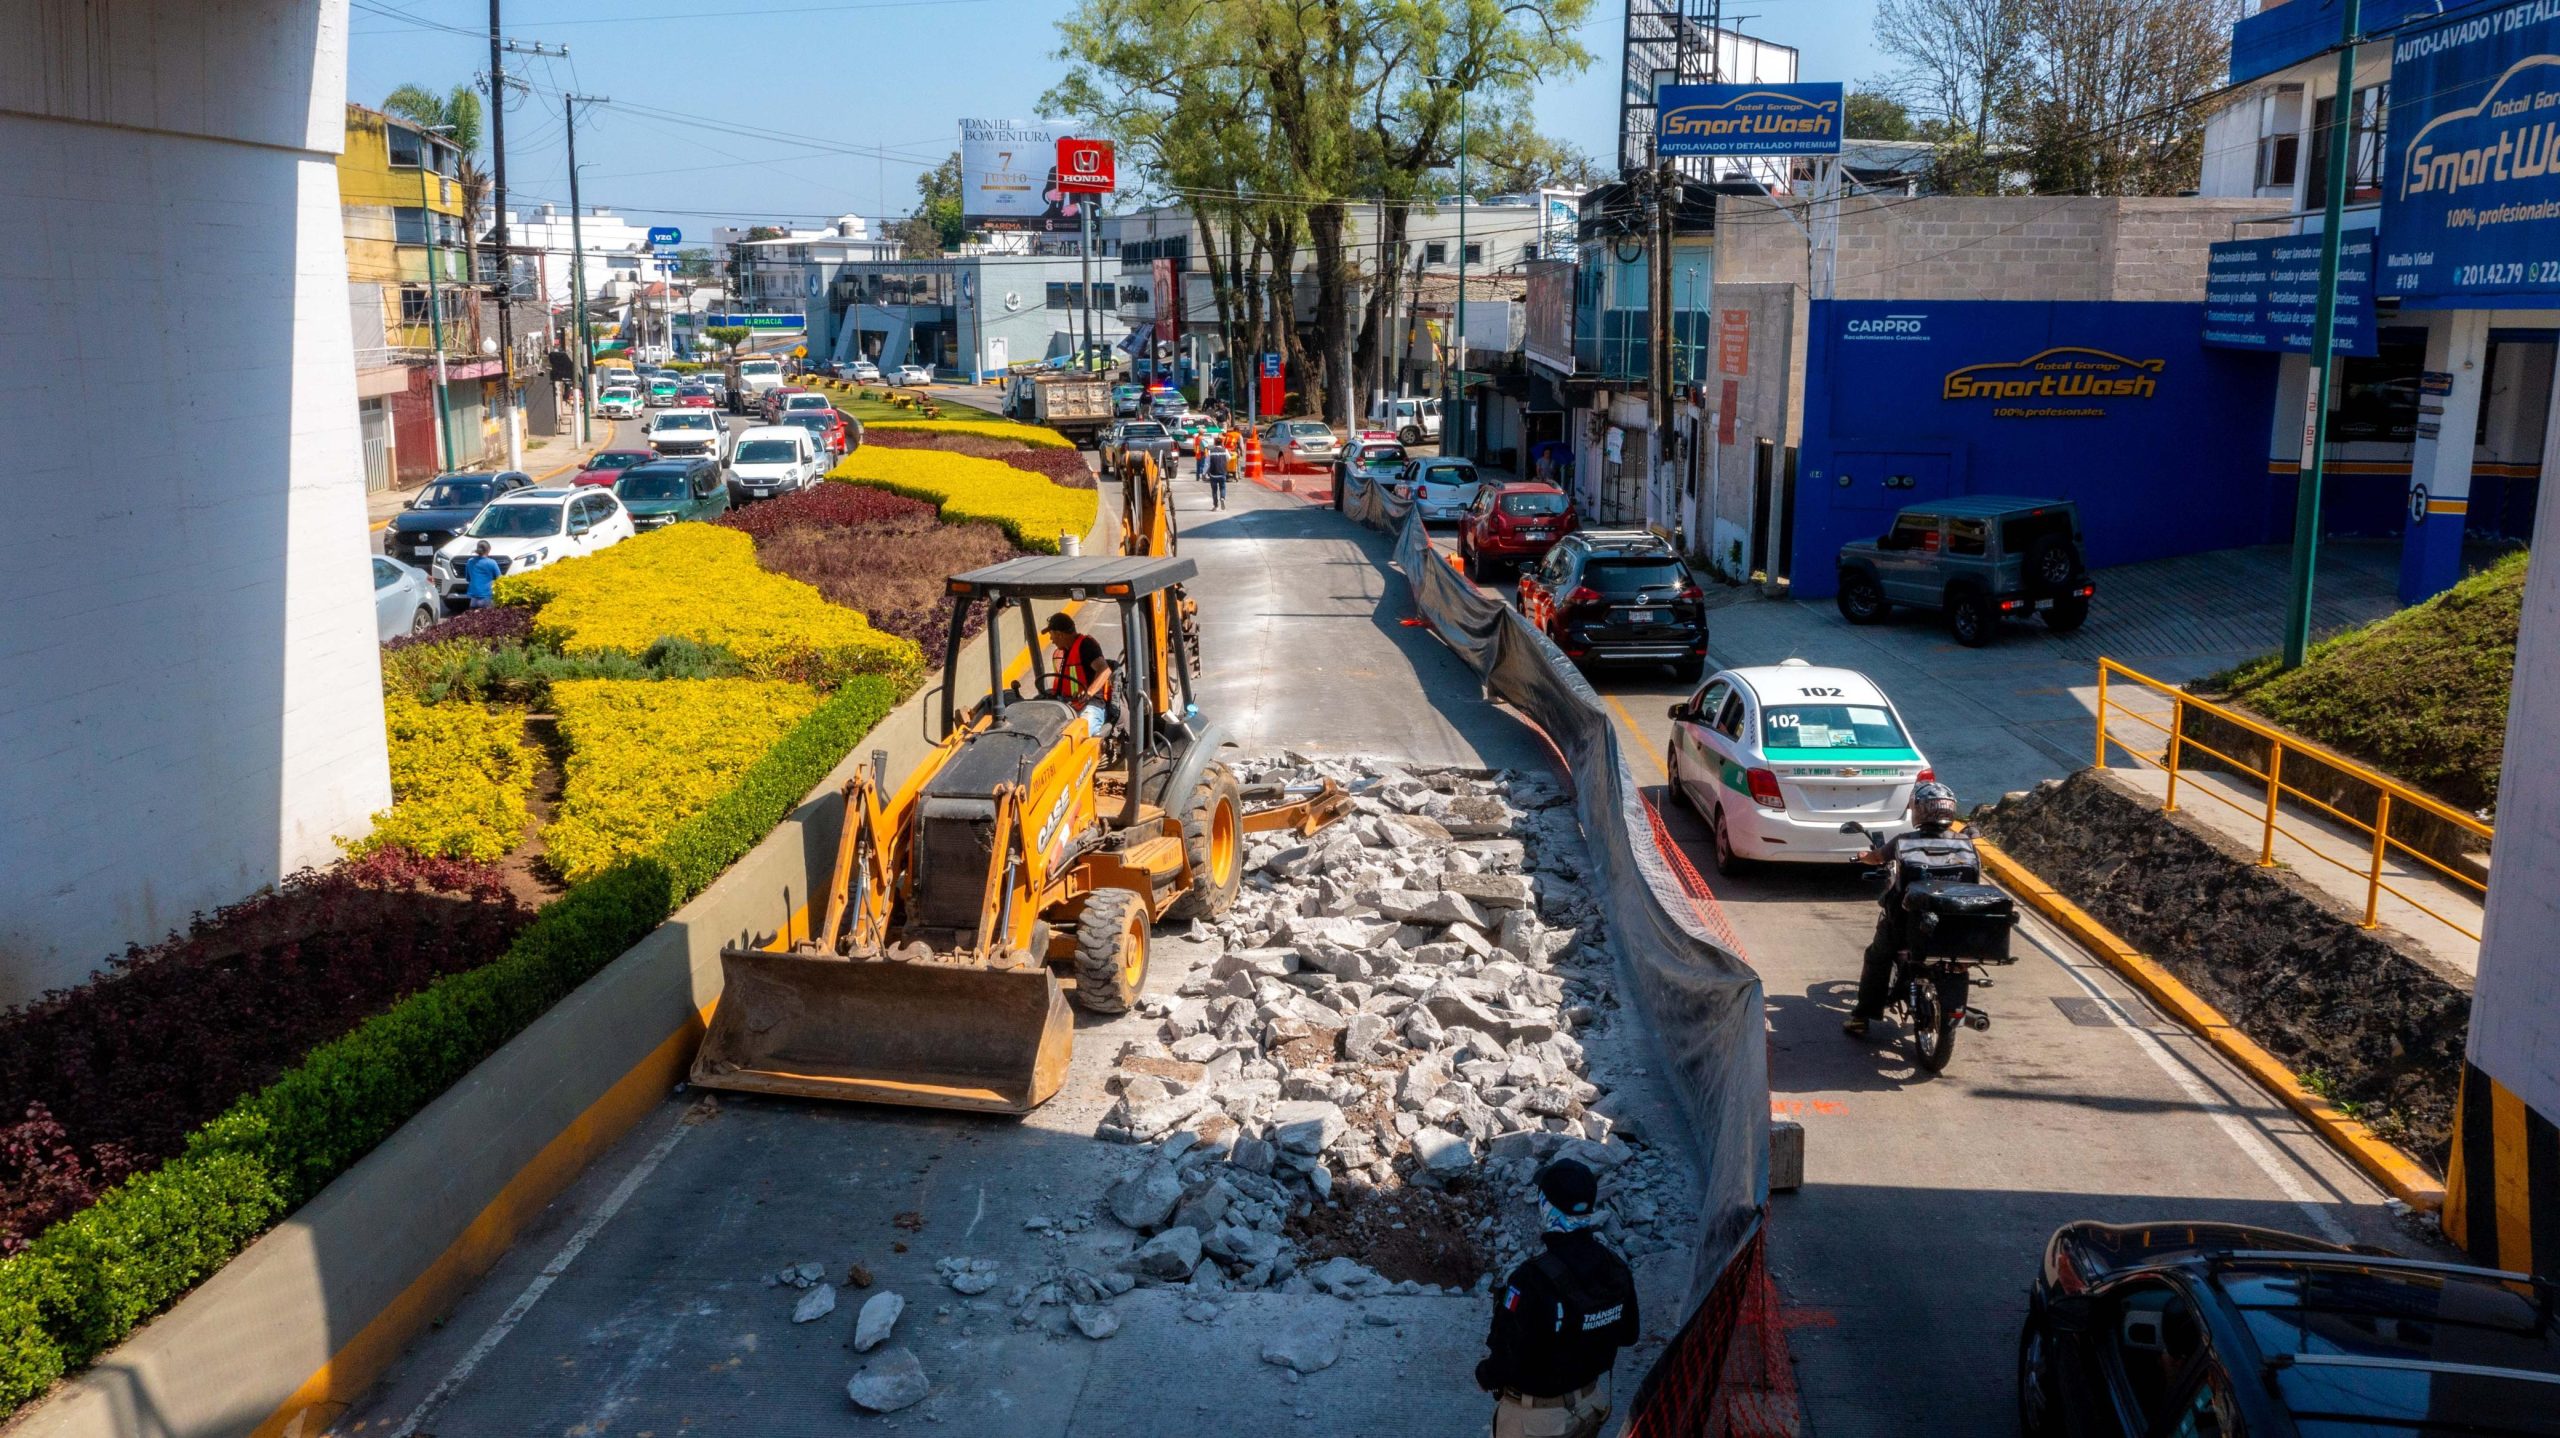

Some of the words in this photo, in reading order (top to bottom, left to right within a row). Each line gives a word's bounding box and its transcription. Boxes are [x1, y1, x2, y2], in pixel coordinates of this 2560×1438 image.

[2395, 17, 2490, 65] AUTO-LAVADO
[2493, 12, 2504, 35] Y
[1767, 103, 1803, 112] Garage
[964, 118, 1014, 131] DANIEL
[1667, 114, 1832, 137] SmartWash
[964, 130, 1052, 143] BOAVENTURA
[1661, 142, 1728, 151] AUTOLAVADO
[1729, 142, 1735, 150] Y
[1737, 141, 1792, 150] DETALLADO
[1793, 141, 1837, 149] PREMIUM
[998, 152, 1012, 172] 7
[984, 173, 1027, 184] JUNIO
[1063, 175, 1109, 183] HONDA
[2446, 208, 2476, 229] 100%
[2414, 251, 2434, 266] Vidal
[2461, 262, 2524, 286] 201.42.79
[1847, 319, 1922, 333] CARPRO
[1266, 353, 1279, 370] E
[2074, 362, 2121, 371] Garage
[1948, 373, 2157, 400] SmartWash
[1797, 687, 1845, 697] 102
[1769, 714, 1800, 728] 102
[1037, 783, 1070, 854] CASE
